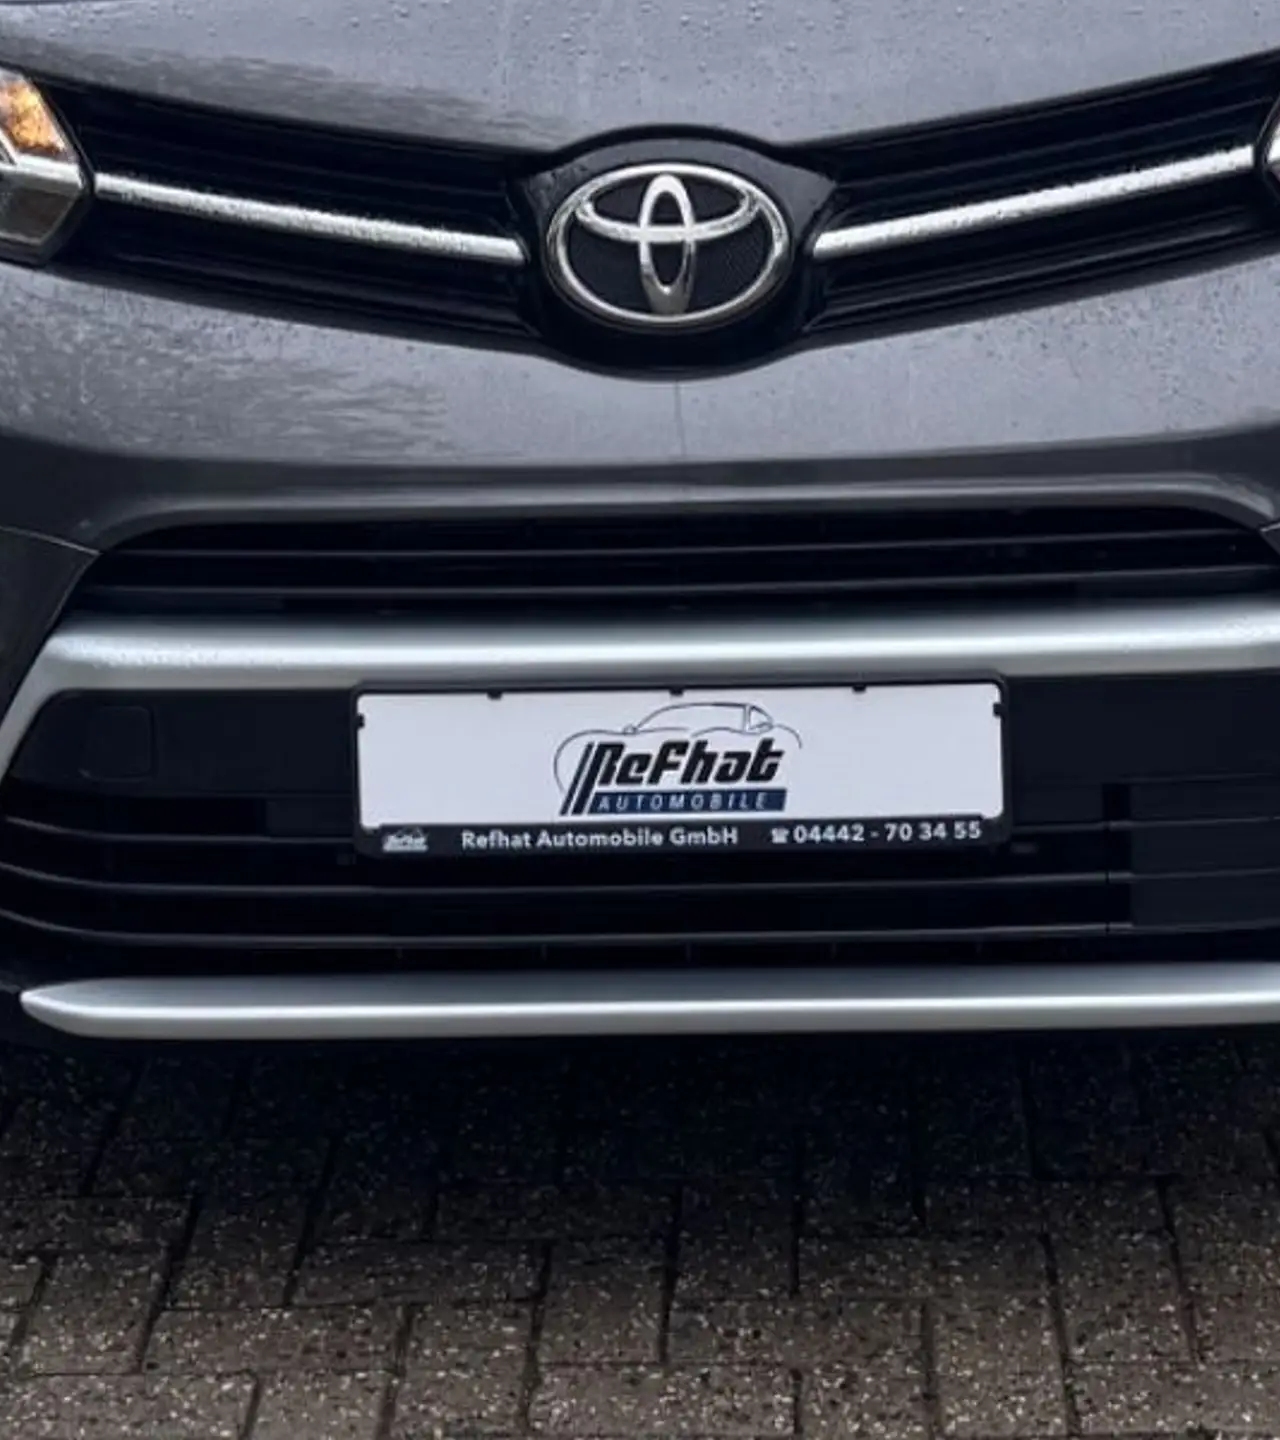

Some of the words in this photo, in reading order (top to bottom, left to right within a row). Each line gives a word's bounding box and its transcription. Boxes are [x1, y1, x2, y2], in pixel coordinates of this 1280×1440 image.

[596, 792, 767, 811] AUTOMOBILE
[462, 829, 531, 849] Refhat
[536, 827, 664, 848] Automobile
[670, 826, 738, 846] GmbH
[793, 824, 865, 844] 04442
[884, 823, 913, 841] 70
[919, 822, 947, 840] 34
[953, 820, 982, 840] 55
